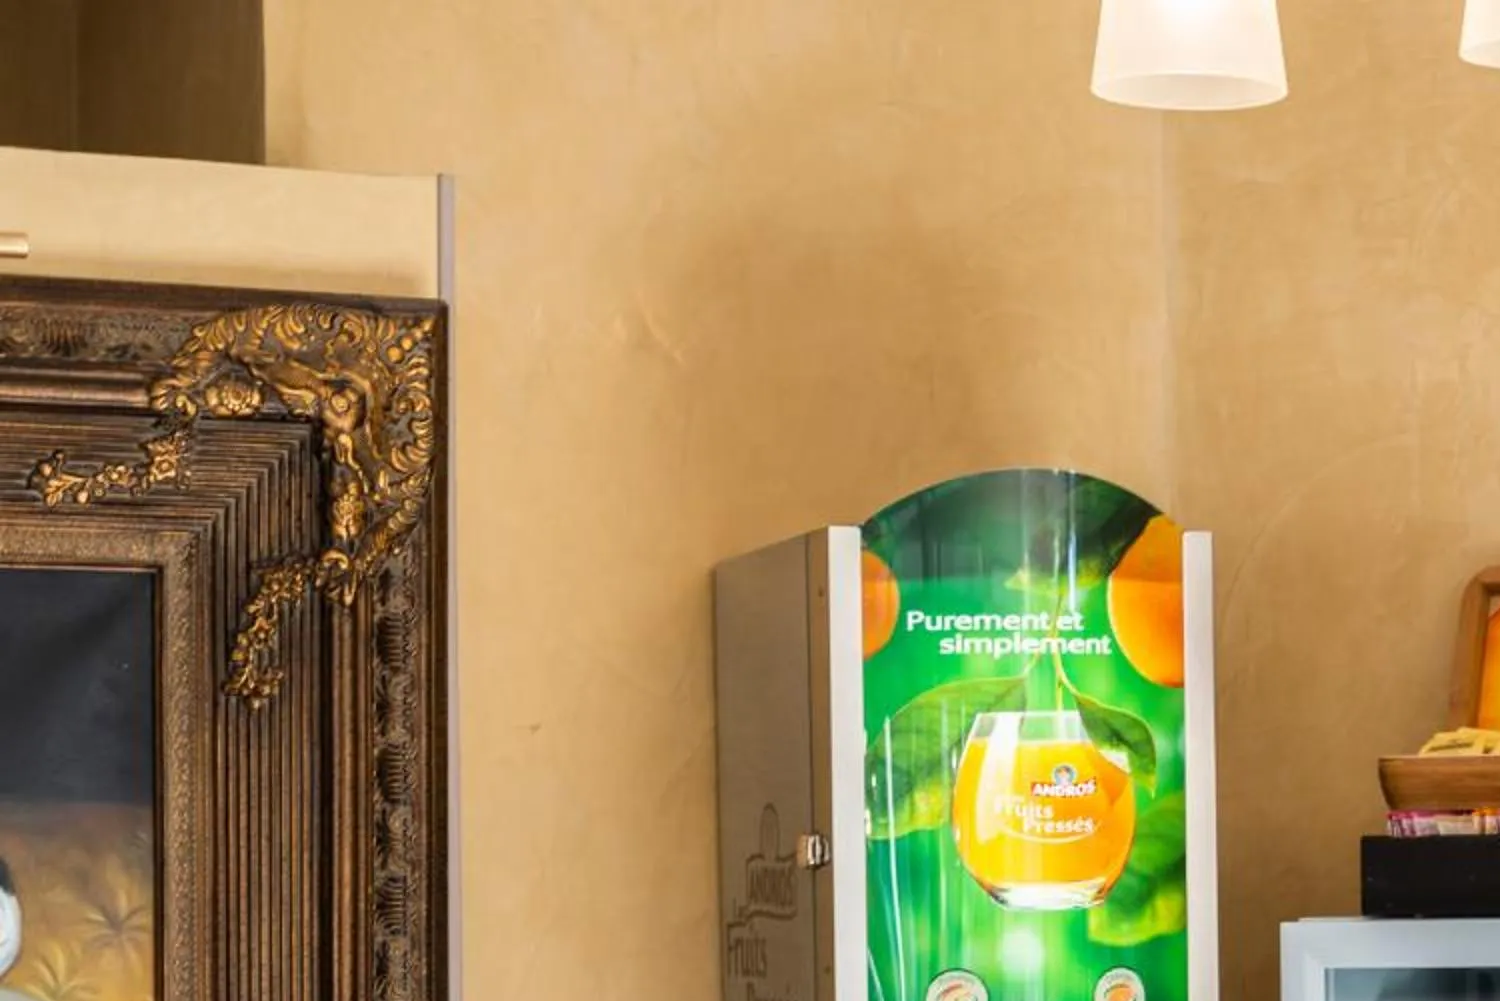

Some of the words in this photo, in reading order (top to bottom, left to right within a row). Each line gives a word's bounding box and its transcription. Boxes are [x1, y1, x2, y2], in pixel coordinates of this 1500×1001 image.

[906, 610, 1050, 632] Purement
[1056, 610, 1084, 632] et
[939, 632, 1113, 661] simplement
[1032, 779, 1096, 798] ANDROS
